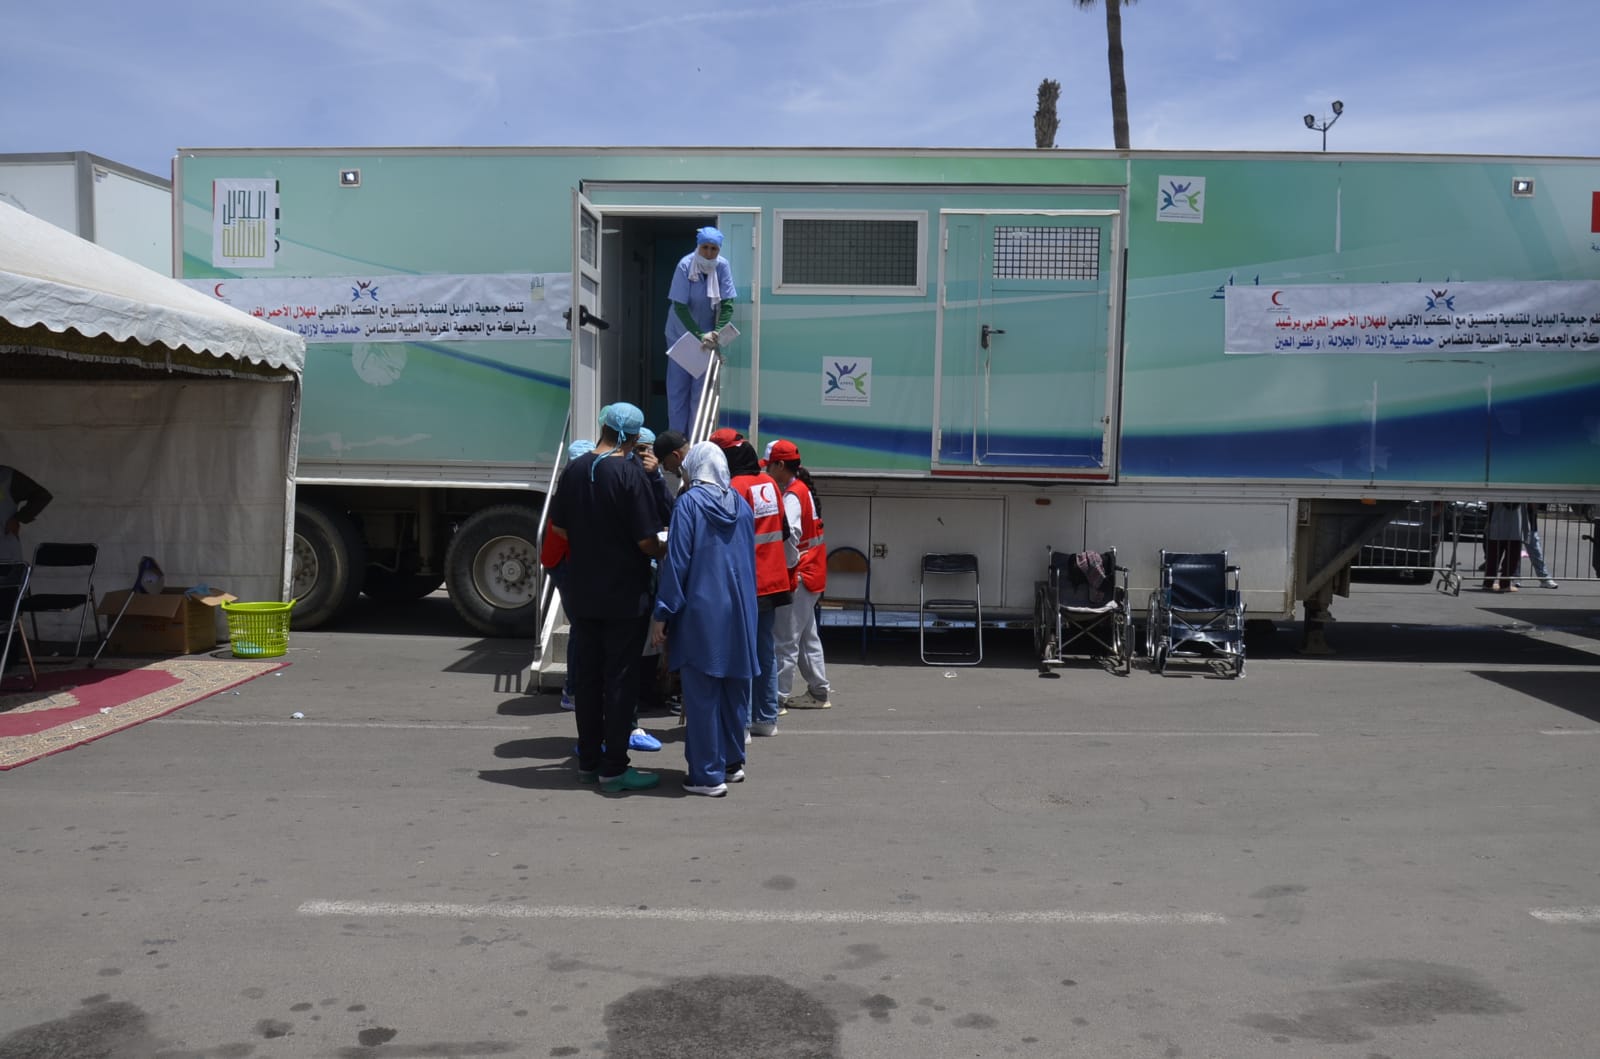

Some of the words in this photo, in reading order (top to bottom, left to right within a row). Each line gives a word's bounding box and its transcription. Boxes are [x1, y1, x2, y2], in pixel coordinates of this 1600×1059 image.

[267, 304, 291, 319] الأحمر
[293, 305, 316, 319] للهلال
[351, 304, 377, 318] المكتب
[379, 305, 388, 319] مع
[390, 303, 417, 317] بتنسيق
[419, 303, 447, 317] للتنمية
[449, 302, 474, 317] البديل
[475, 302, 501, 316] جمعية
[503, 302, 524, 316] تنظم
[1302, 315, 1328, 332] المغربي
[1330, 312, 1358, 329] الأحمر
[1360, 315, 1386, 329] للهلال
[1423, 314, 1453, 328] المكتب
[1455, 317, 1466, 329] مع
[1468, 313, 1497, 328] بتنسيق
[1499, 313, 1530, 328] للتنمية
[1532, 312, 1558, 328] البديل
[1560, 312, 1587, 328] جمعية
[320, 323, 339, 337] طبية
[341, 323, 361, 334] حملة
[365, 322, 397, 337] للتضامن
[398, 321, 423, 336] الطبية
[425, 321, 452, 336] المغربية
[454, 321, 485, 335] الجمعية
[486, 323, 495, 336] مع
[1275, 335, 1295, 350] العين
[1390, 334, 1410, 349] طبية
[1412, 334, 1435, 345] حملة
[1438, 333, 1474, 349] للتضامن
[1475, 332, 1503, 348] الطبية
[1504, 332, 1534, 348] المغربية
[1535, 332, 1569, 347] الجمعية
[1570, 335, 1581, 348] مع
